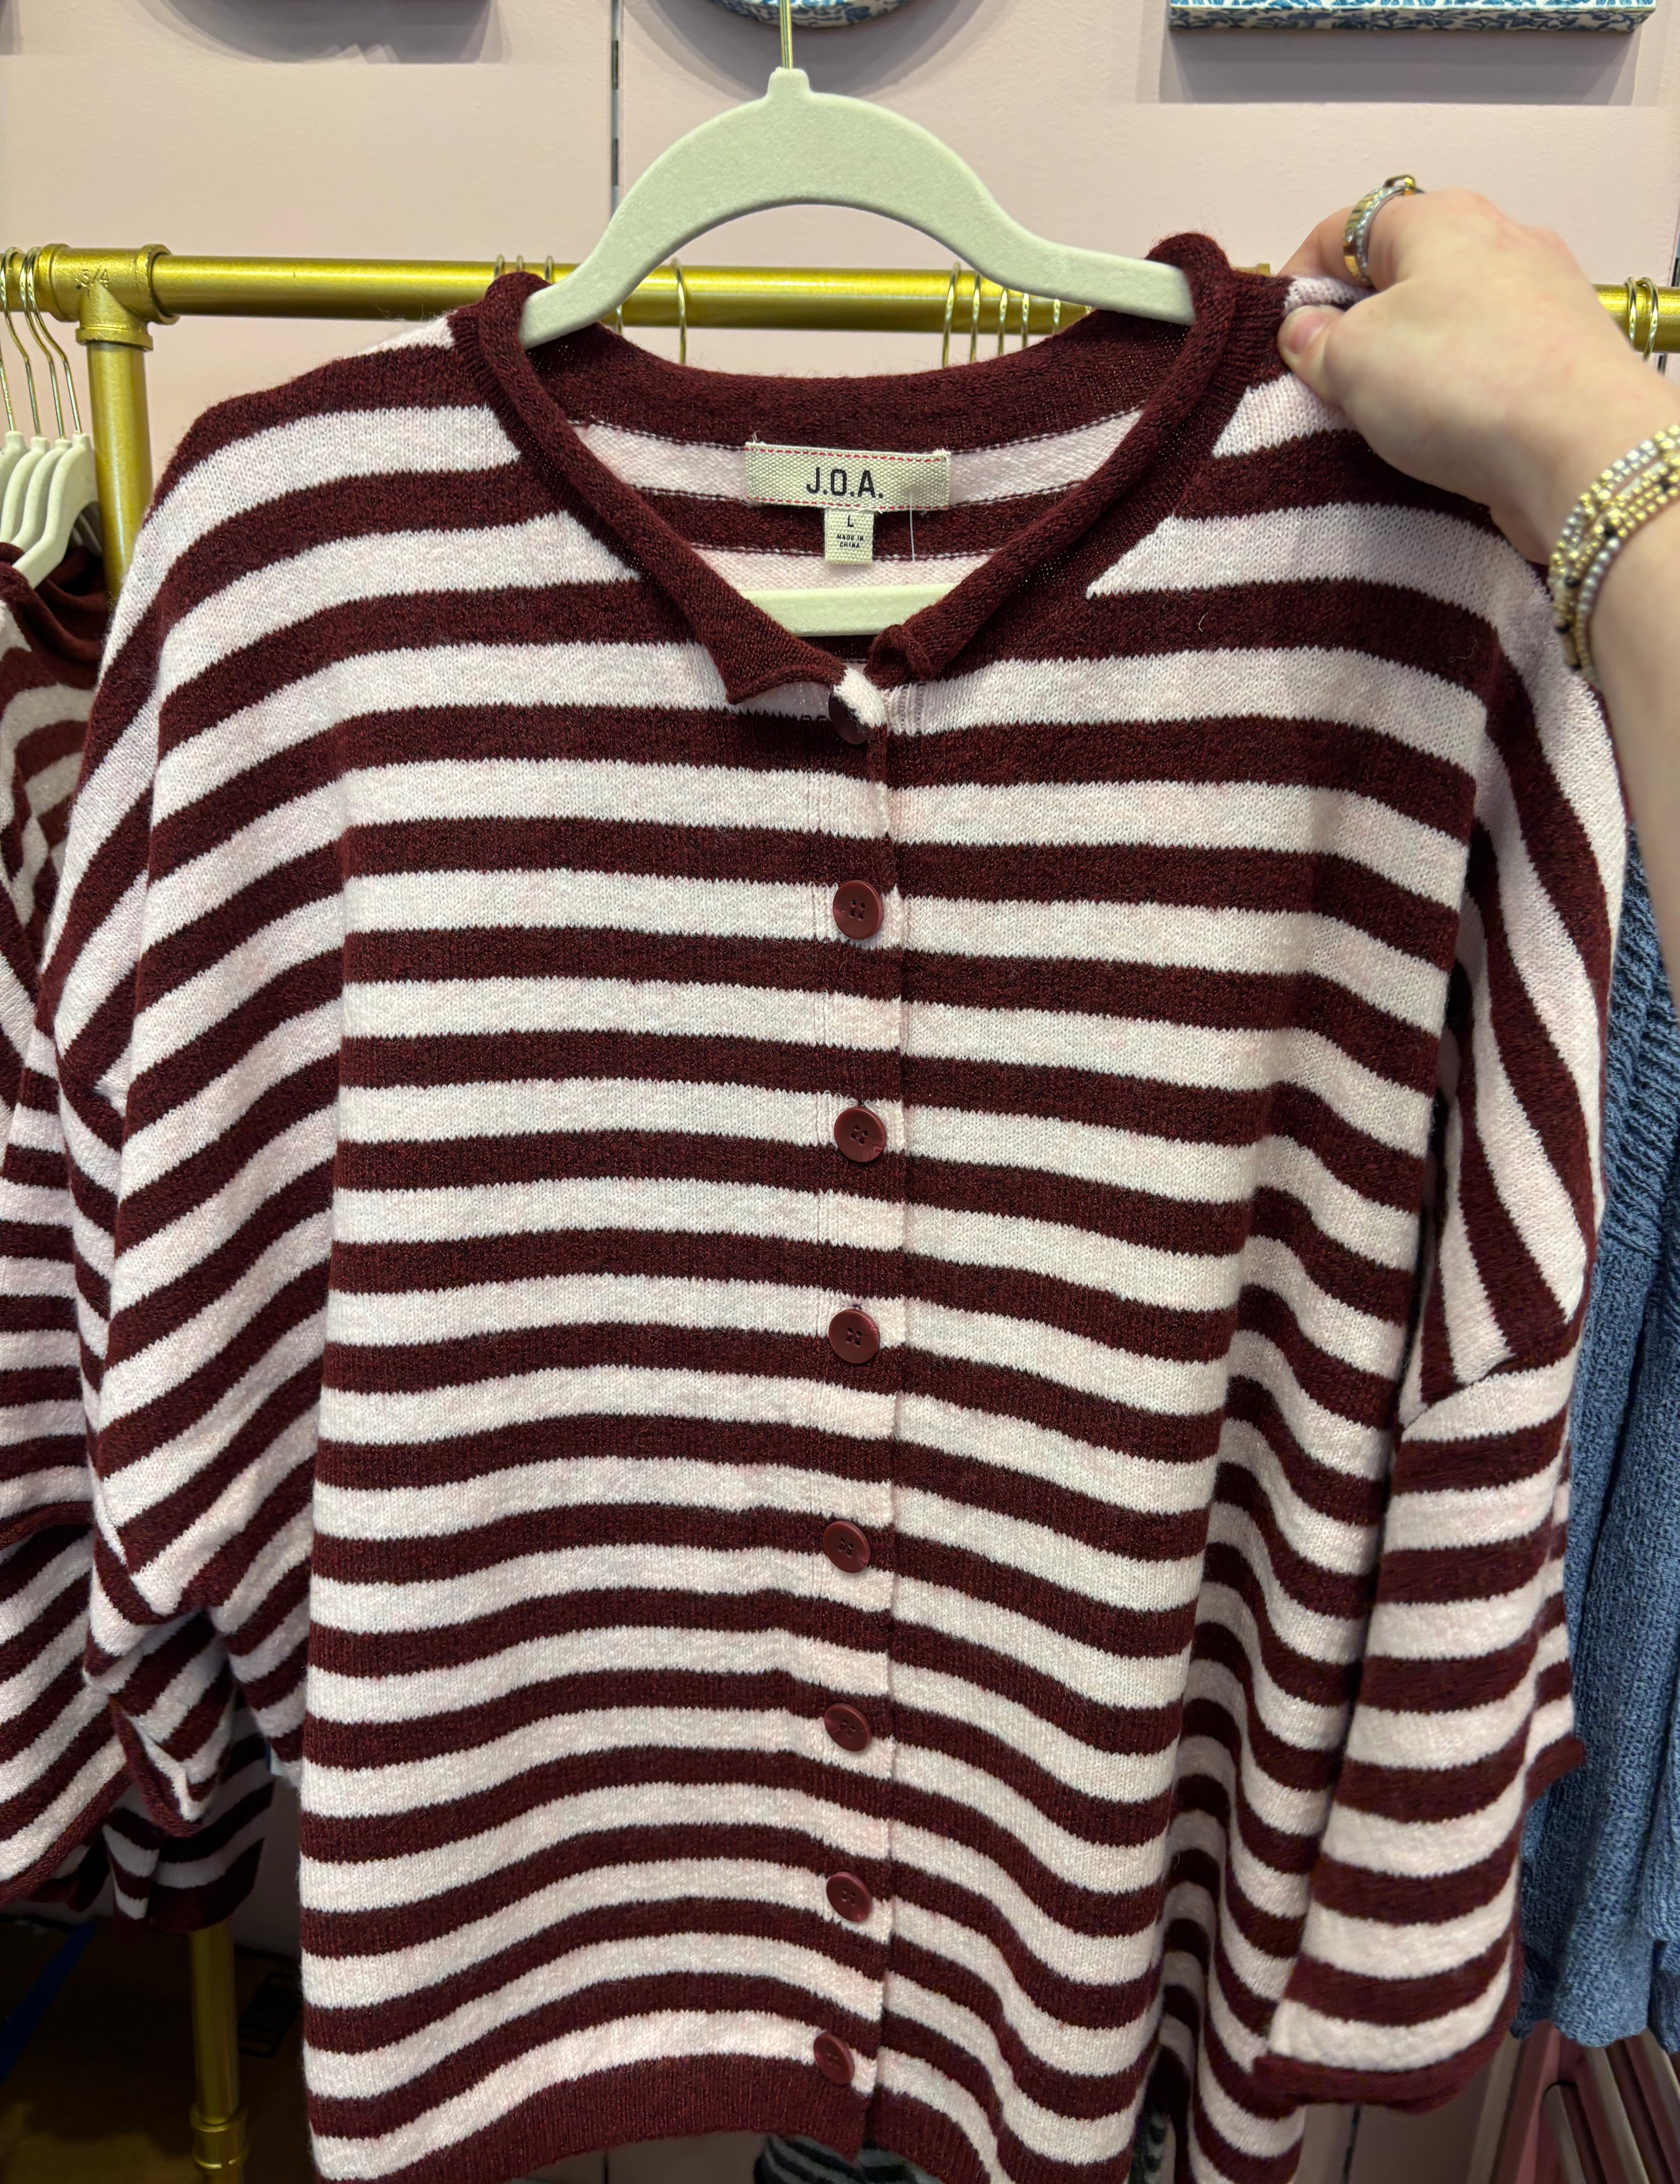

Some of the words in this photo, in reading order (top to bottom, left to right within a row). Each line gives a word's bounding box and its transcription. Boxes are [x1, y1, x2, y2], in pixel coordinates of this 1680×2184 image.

[81, 268, 109, 288] 3/4
[806, 467, 883, 498] J.O.A.
[847, 515, 854, 527] L
